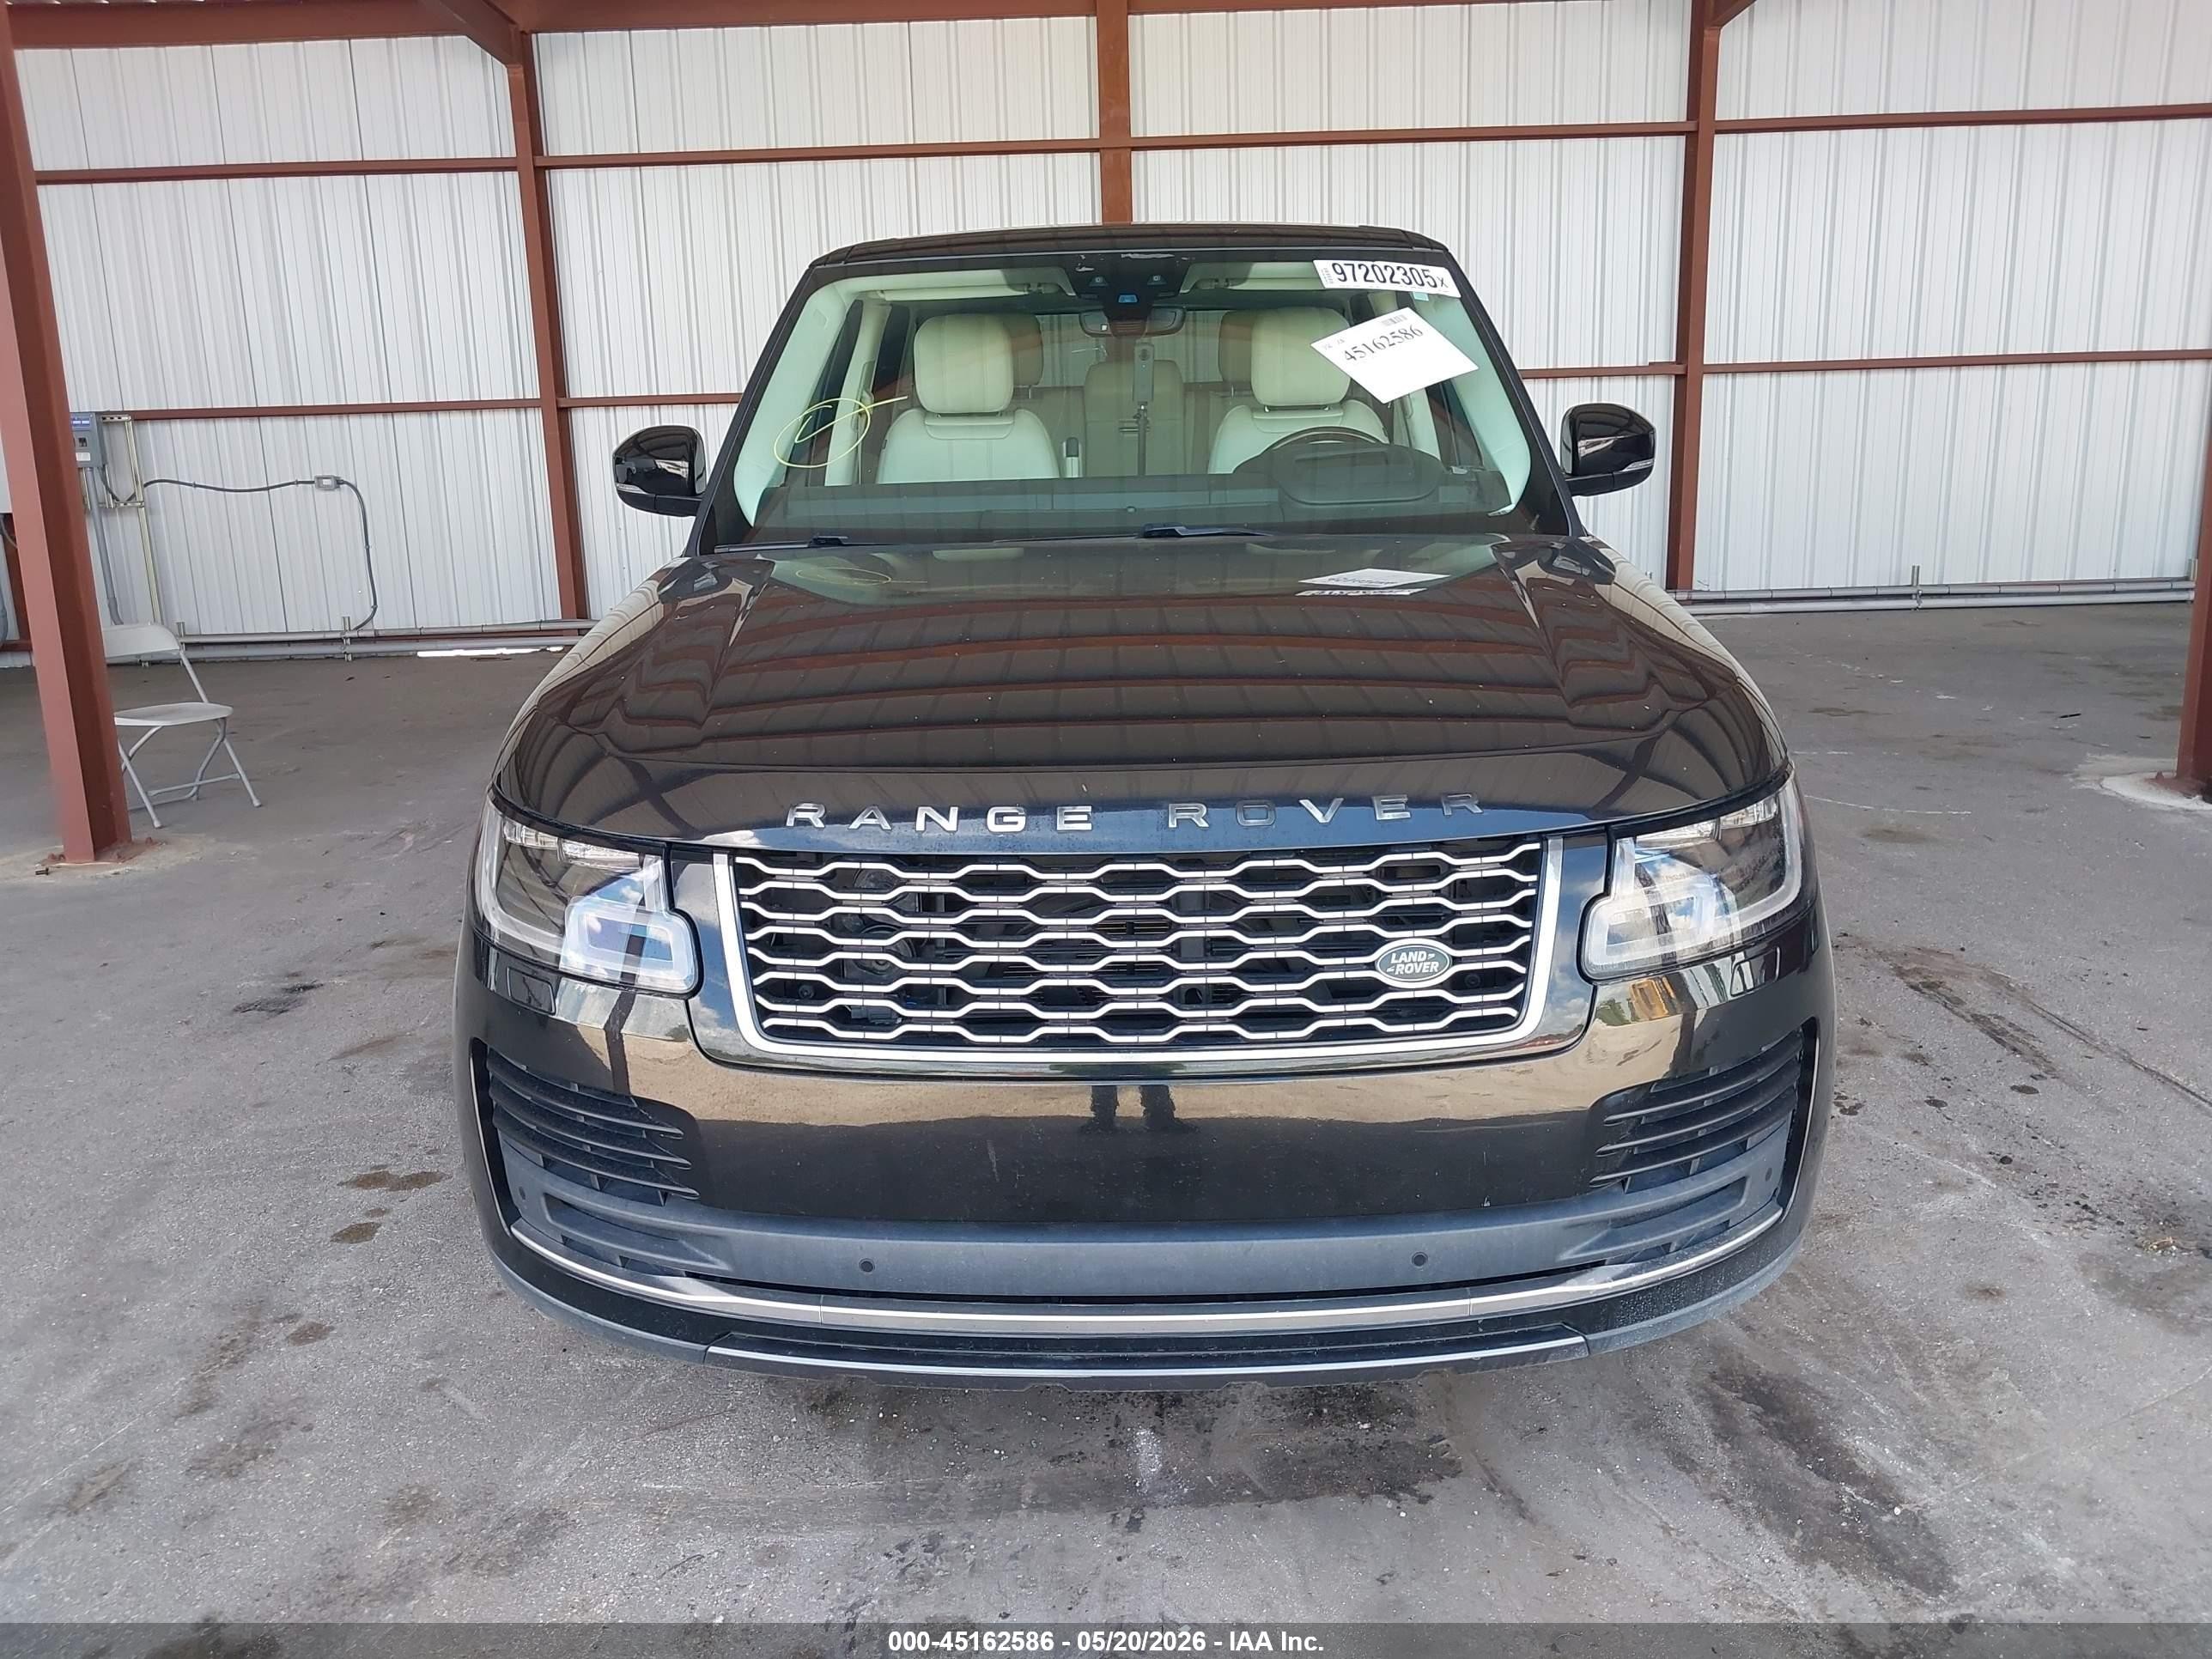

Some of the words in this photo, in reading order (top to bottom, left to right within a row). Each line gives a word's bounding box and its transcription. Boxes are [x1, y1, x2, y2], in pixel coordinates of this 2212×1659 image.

[1344, 325, 1424, 361] 45162586
[786, 803, 1093, 831] RANGE
[1168, 793, 1483, 828] ROVER
[1390, 951, 1427, 964] LAND
[1395, 961, 1440, 975] ROVER
